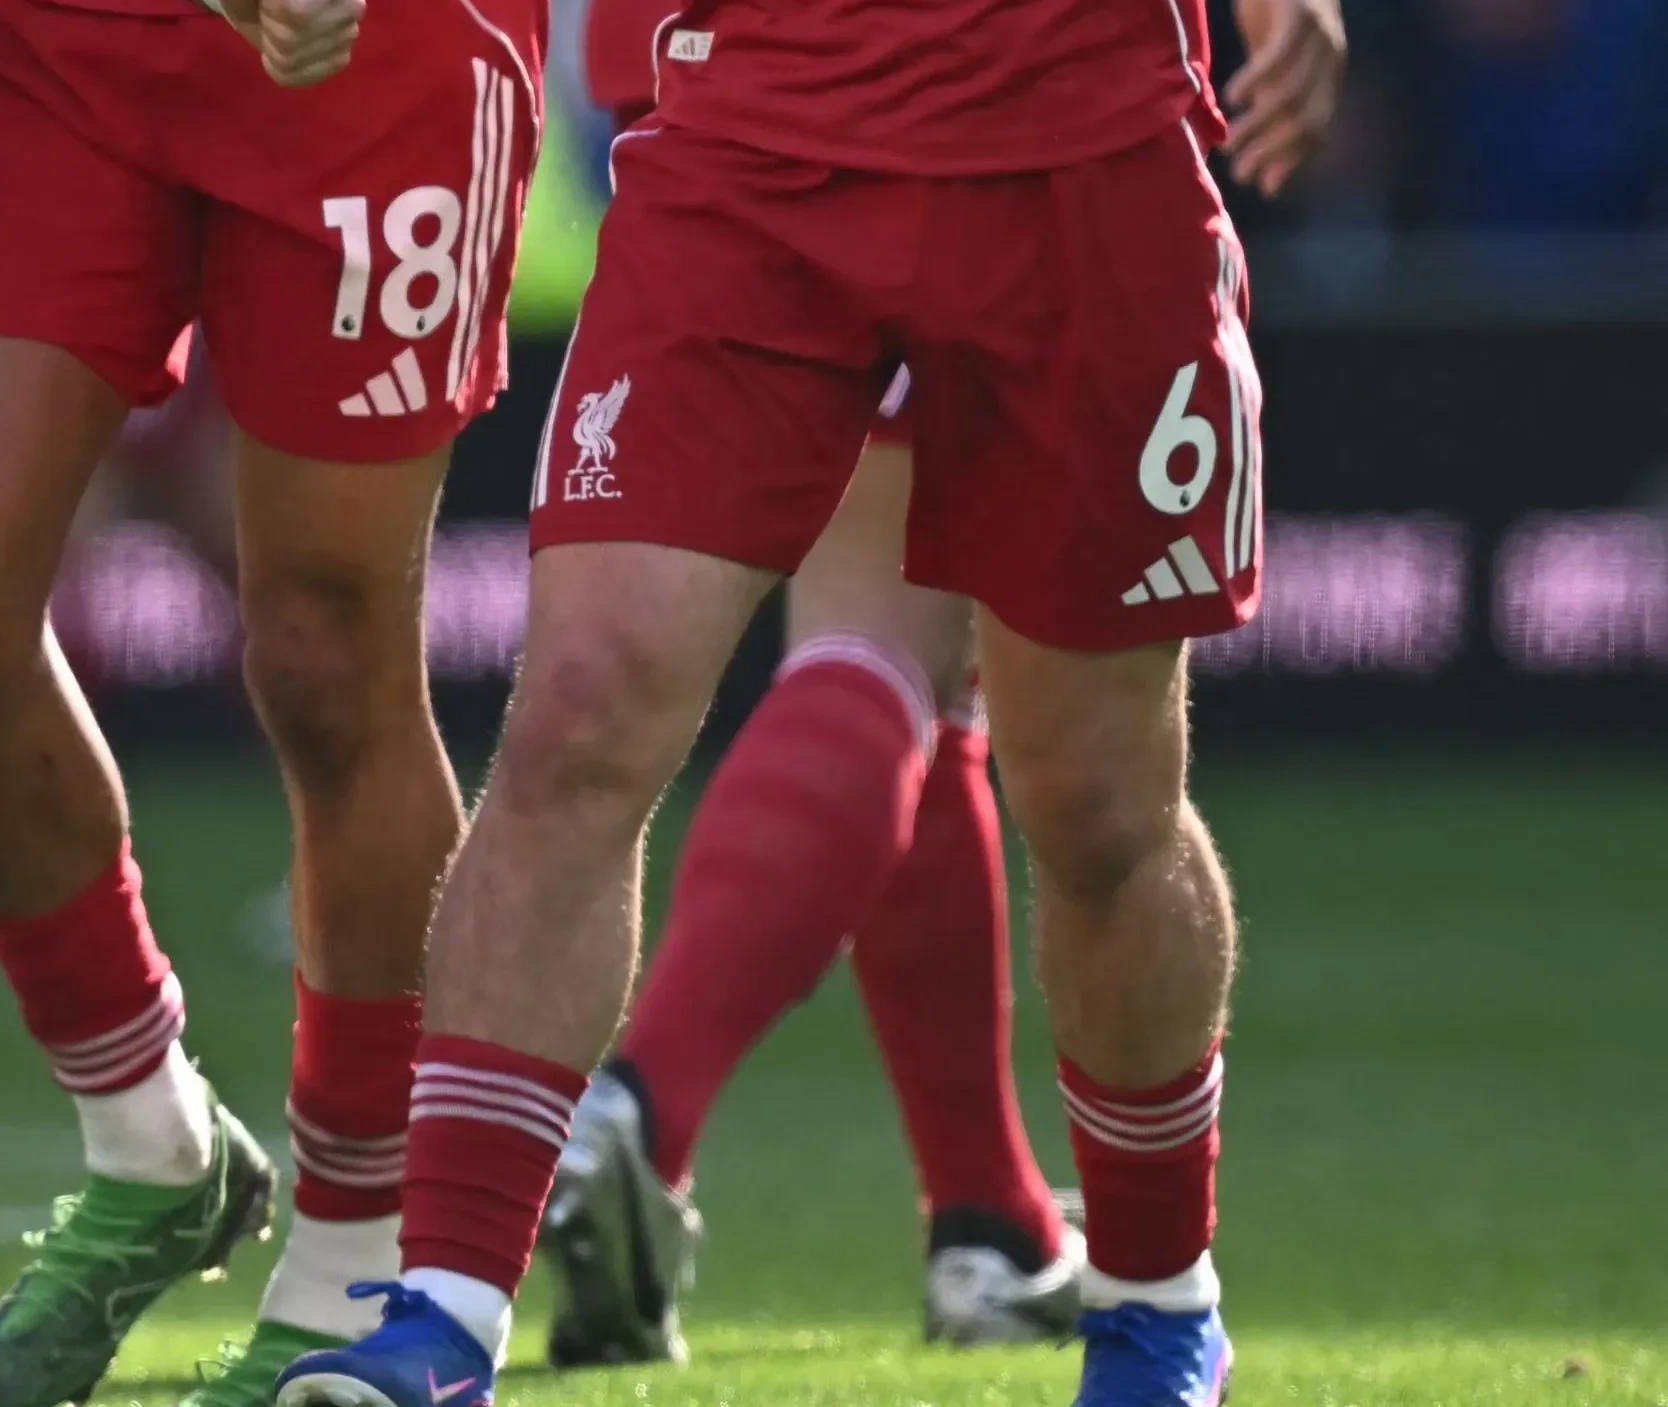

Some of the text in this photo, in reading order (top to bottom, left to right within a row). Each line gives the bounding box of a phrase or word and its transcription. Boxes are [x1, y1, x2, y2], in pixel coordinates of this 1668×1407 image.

[322, 185, 462, 341] 18
[563, 473, 623, 501] L.F.C.
[1139, 359, 1217, 515] 6
